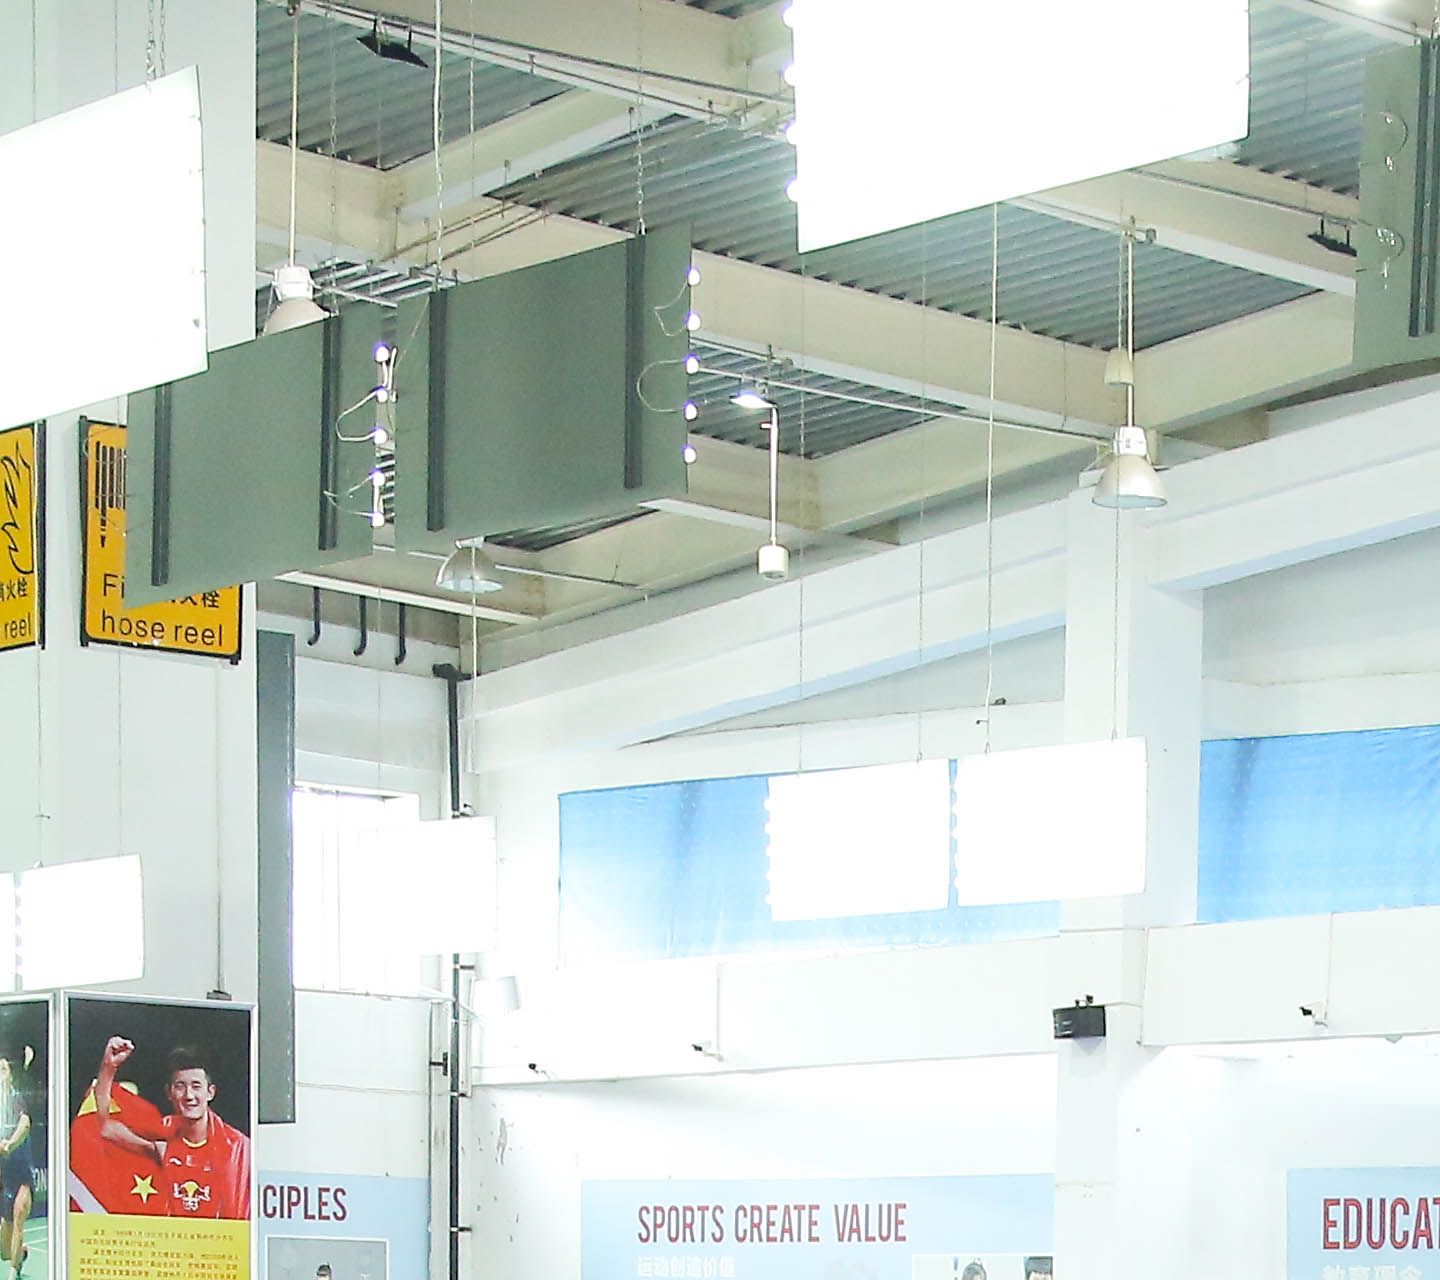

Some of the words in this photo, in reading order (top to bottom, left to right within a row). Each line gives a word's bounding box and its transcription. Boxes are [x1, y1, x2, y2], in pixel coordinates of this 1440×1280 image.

[4, 612, 32, 640] reel
[102, 610, 165, 640] hose
[175, 624, 222, 647] reel
[258, 1184, 347, 1221] CIPLES
[638, 1204, 724, 1243] SPORTS
[734, 1204, 820, 1243] CREATE
[834, 1203, 907, 1242] VALUE
